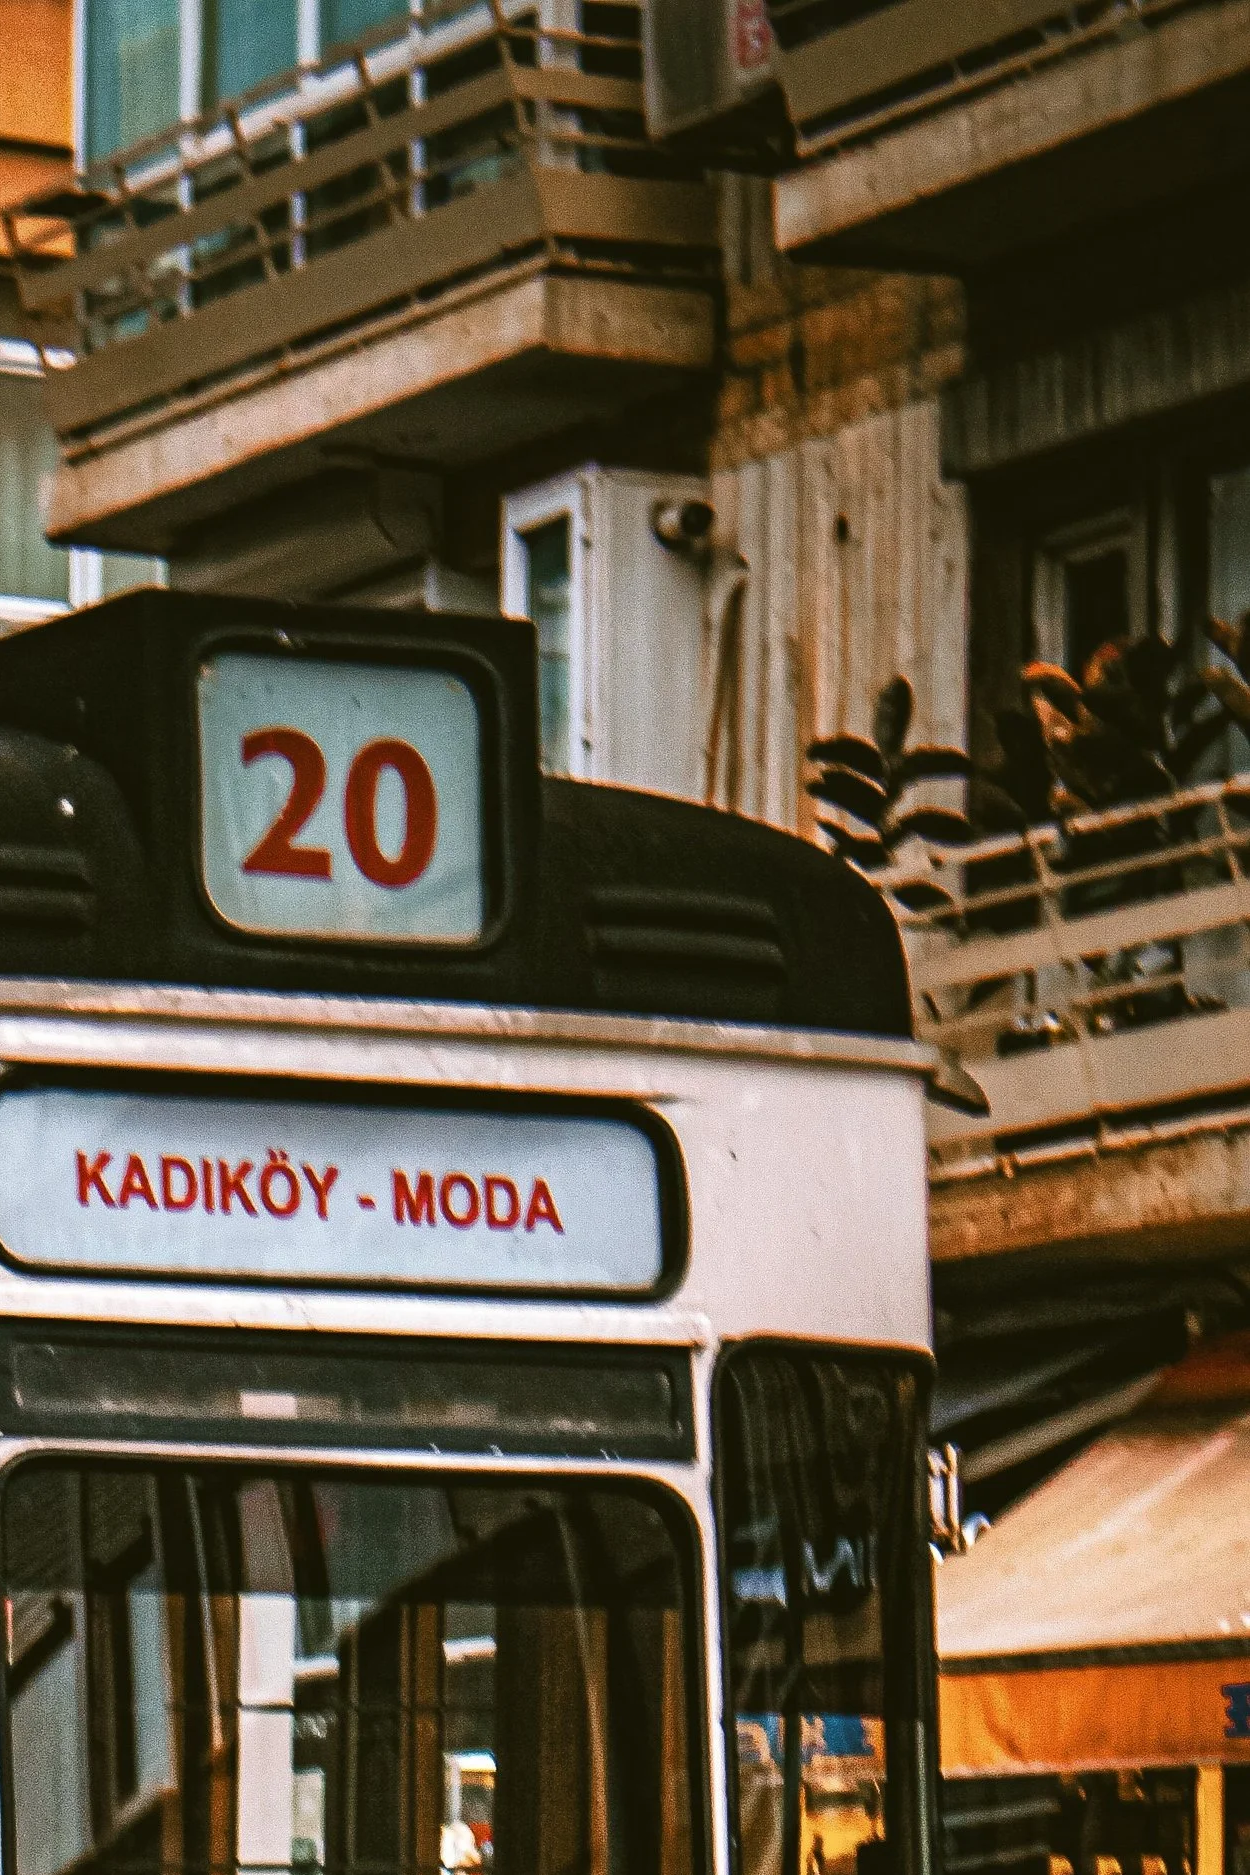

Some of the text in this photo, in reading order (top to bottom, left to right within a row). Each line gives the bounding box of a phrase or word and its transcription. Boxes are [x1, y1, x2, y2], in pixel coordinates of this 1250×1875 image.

[241, 724, 439, 890] 20
[76, 1147, 339, 1221] KADIKÖY
[392, 1167, 565, 1235] MODA
